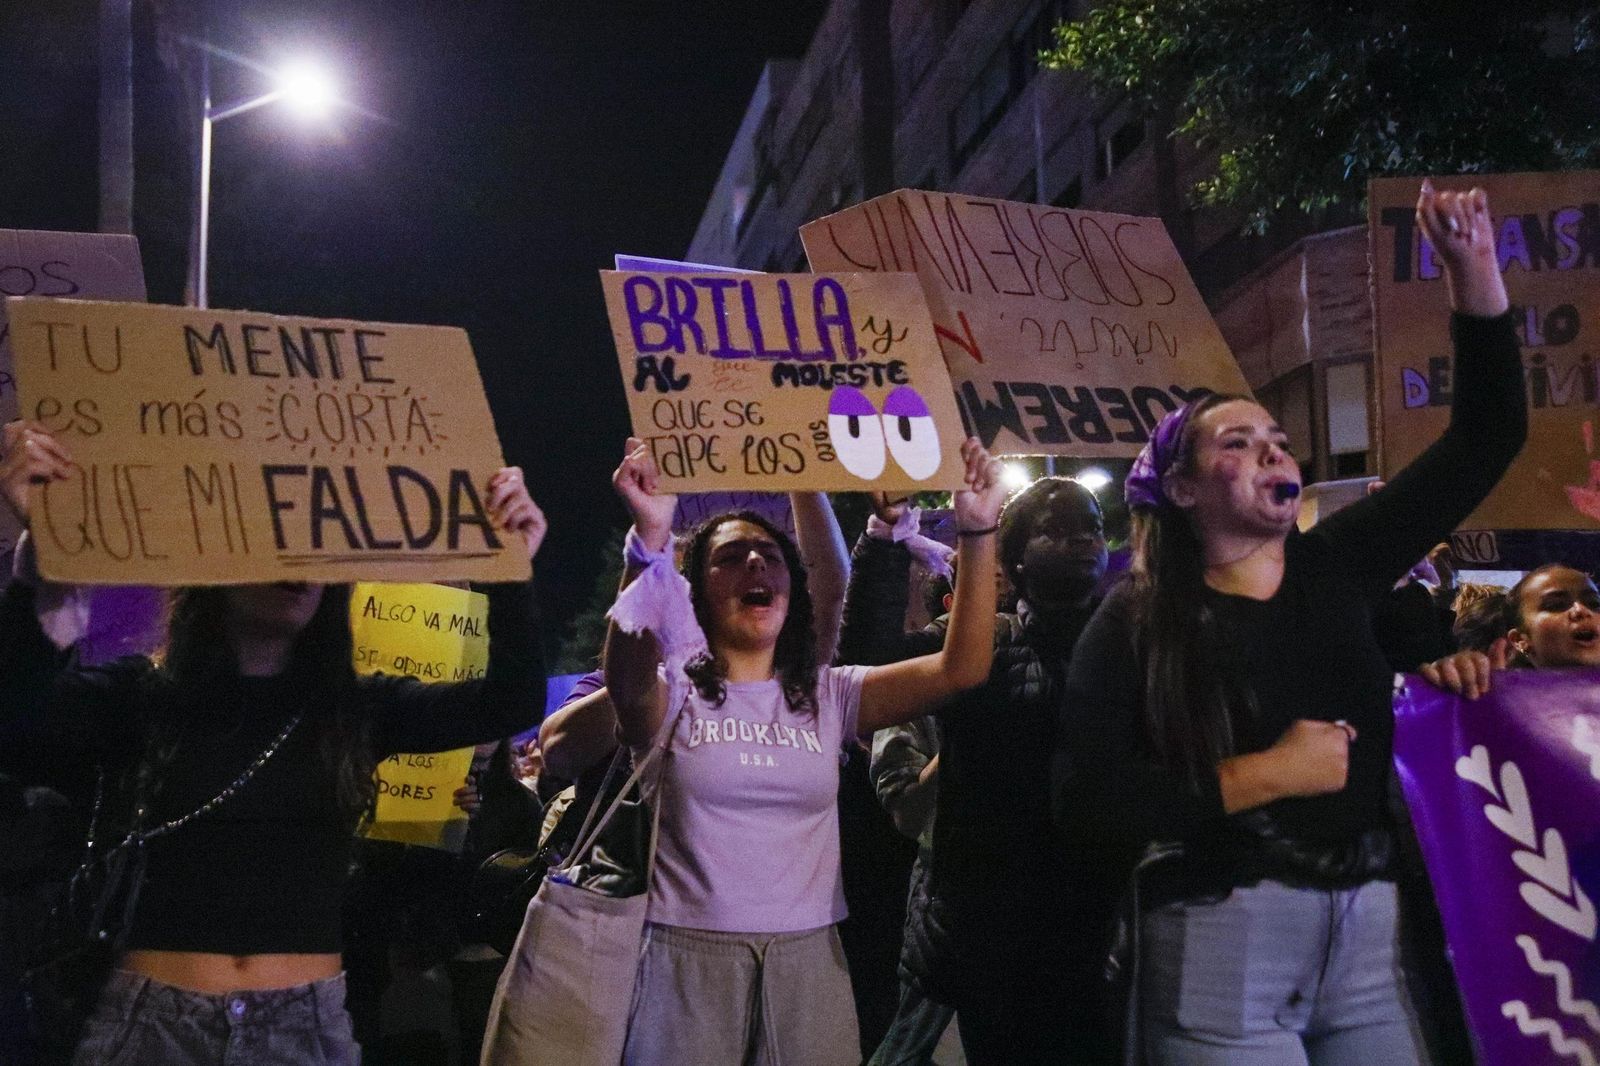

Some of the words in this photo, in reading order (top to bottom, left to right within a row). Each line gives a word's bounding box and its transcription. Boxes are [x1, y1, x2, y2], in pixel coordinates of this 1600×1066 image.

[31, 320, 123, 374] TU
[183, 323, 396, 384] MENTE
[634, 355, 691, 394] AL
[771, 360, 910, 389] MOLESTE
[36, 398, 103, 438] es
[140, 388, 244, 441] más
[278, 391, 434, 447] CORTA
[652, 398, 715, 431] QUE
[723, 399, 766, 430] SE
[42, 462, 169, 563] QUE
[185, 461, 252, 557] MI
[261, 463, 504, 552] FALDA
[362, 596, 416, 623] ALGO
[423, 610, 441, 632] VA
[449, 614, 482, 638] MAL
[688, 717, 823, 754] BROOKLYN
[407, 754, 435, 769] LOS
[739, 752, 780, 768] U.S.A.
